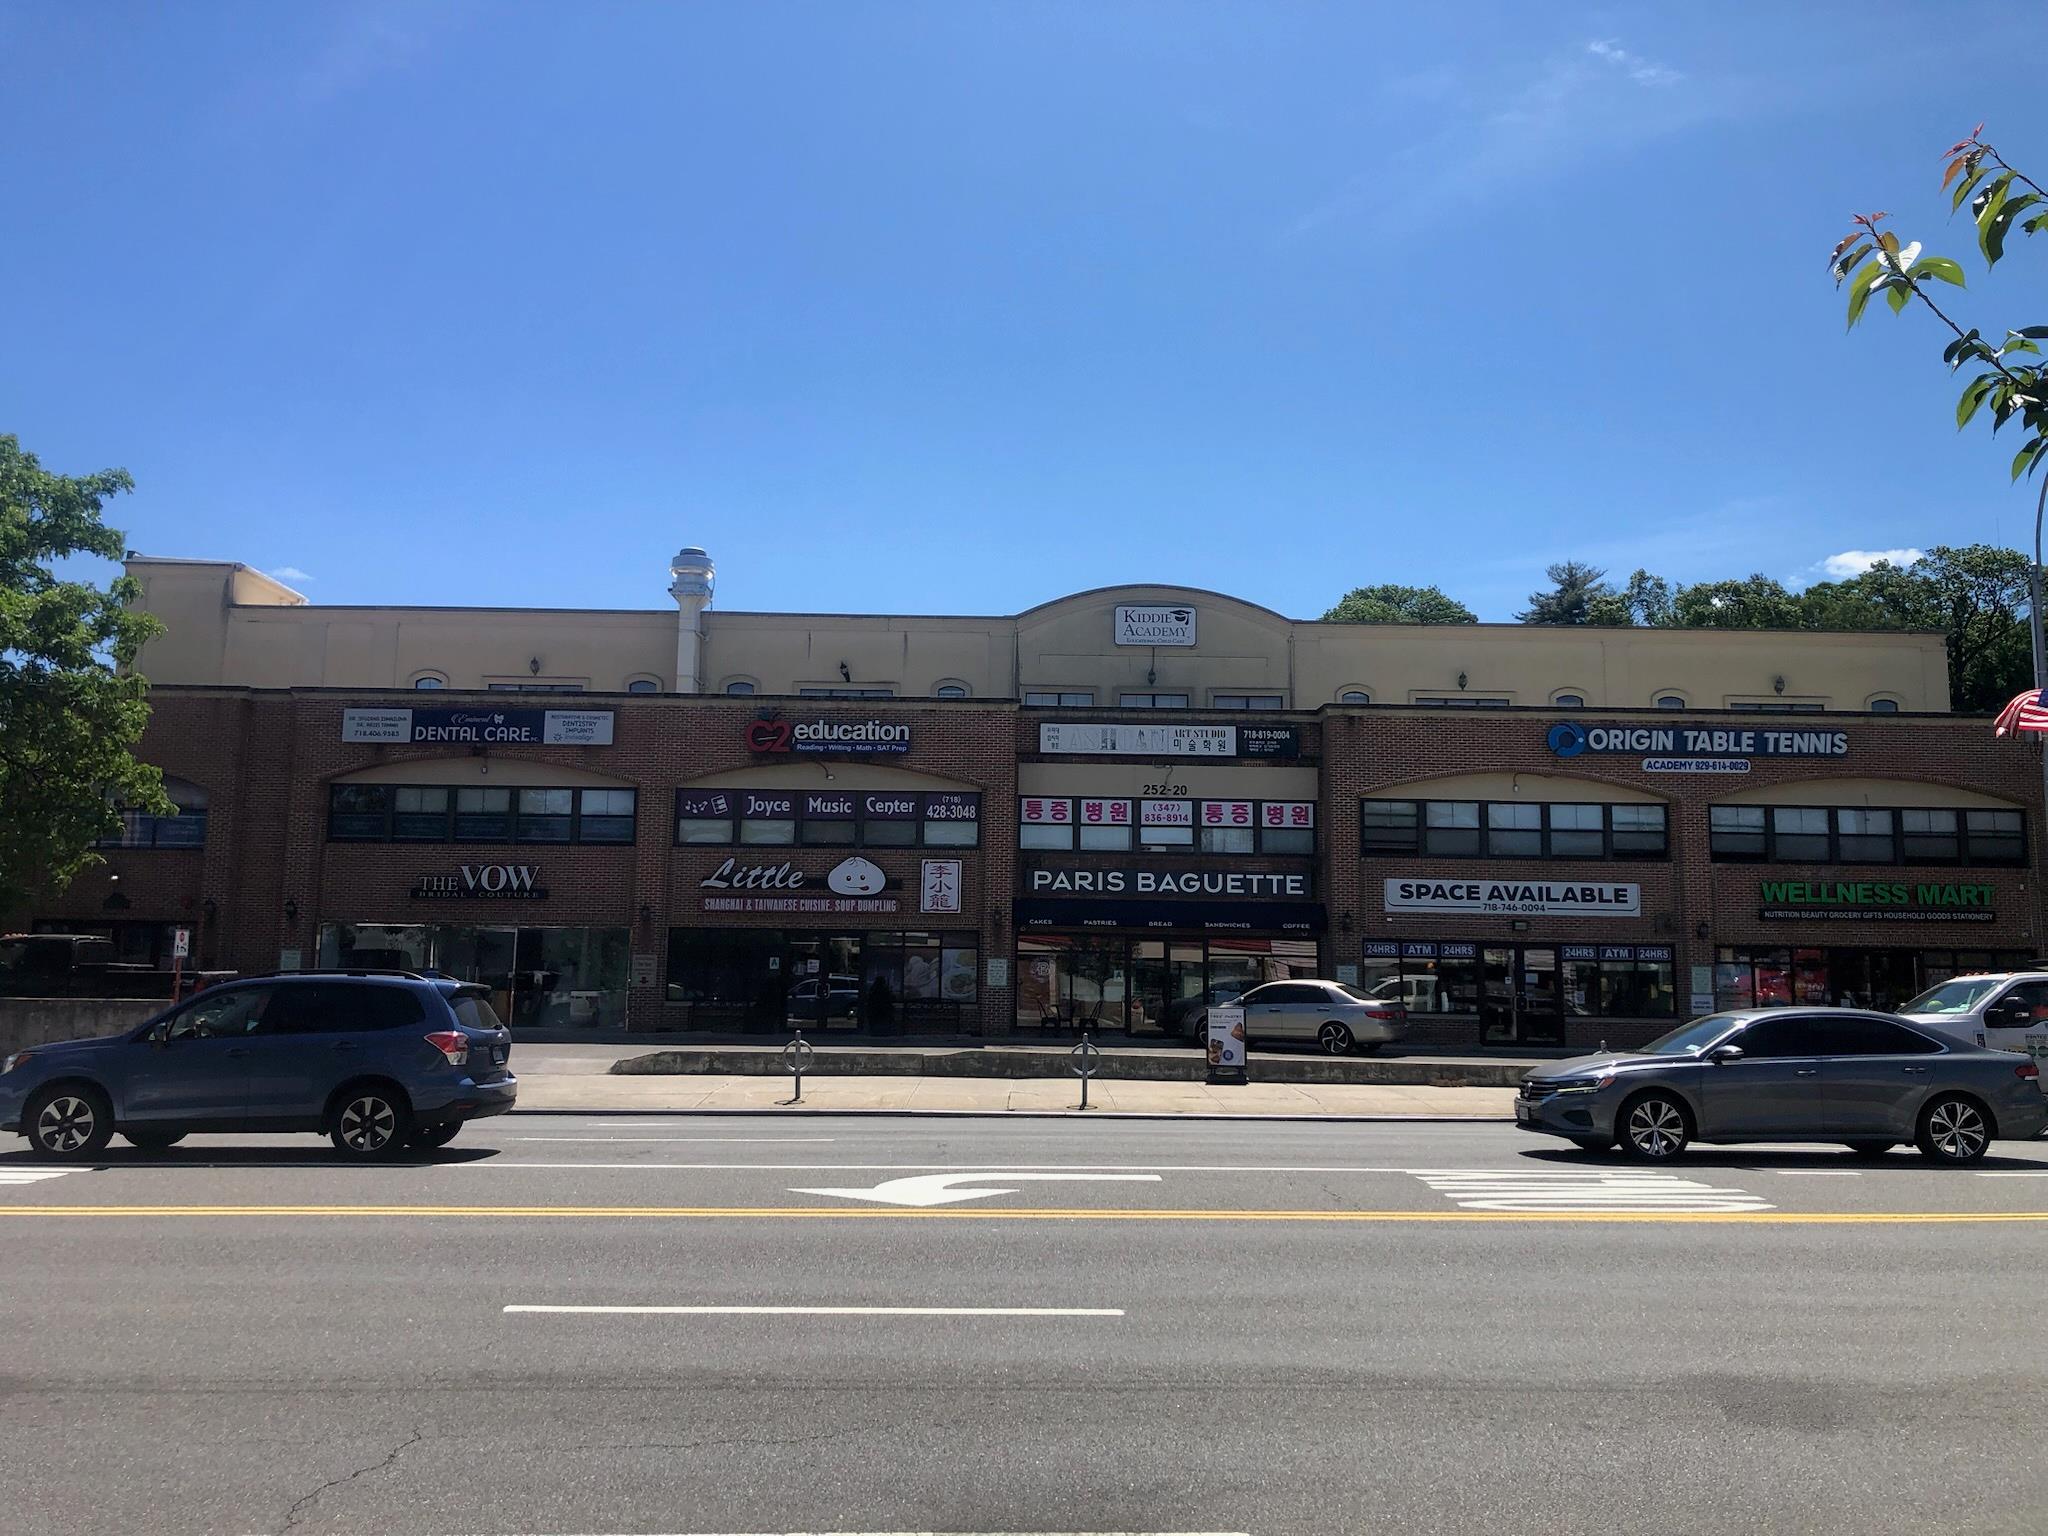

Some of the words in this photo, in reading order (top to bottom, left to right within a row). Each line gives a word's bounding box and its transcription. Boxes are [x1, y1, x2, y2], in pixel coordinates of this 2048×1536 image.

[1124, 609, 1172, 623] KIDDIE
[1123, 623, 1187, 637] ACADEMY
[414, 726, 479, 742] DENTAL
[484, 726, 531, 742] CARE
[794, 719, 910, 741] education
[1174, 729, 1192, 738] ART
[1243, 729, 1290, 740] 718-819-0004
[797, 743, 825, 752] Reading
[828, 744, 852, 752] Writing
[855, 744, 873, 752] Math
[877, 744, 890, 752] SAT
[891, 744, 908, 753] Prep
[1173, 738, 1226, 752] 미술학원
[1588, 727, 1674, 752] ORIGIN
[1683, 729, 1755, 753] TABLE
[1764, 732, 1848, 755] TENNIS
[1646, 761, 1693, 770] ACADEMY
[1695, 761, 1749, 771] 929-614-0029
[1143, 784, 1187, 796] 252-20
[746, 796, 791, 816] Joyce
[808, 797, 852, 814] Music
[866, 796, 915, 816] Center
[926, 804, 976, 819] 428-3048
[1152, 803, 1181, 812] (347)
[1144, 813, 1189, 823] 836-8914
[418, 876, 459, 891] THE
[460, 865, 541, 891] VOW
[700, 858, 807, 890] Little
[1033, 870, 1126, 892] PARIS
[1137, 872, 1305, 895] BAGUETTE
[478, 891, 539, 899] COUTURE
[1399, 883, 1481, 901] SPACE
[1487, 885, 1629, 904] AVAILABLE
[1761, 881, 1910, 905] WELLNESS
[1915, 883, 1997, 907] MART
[704, 898, 743, 911] SHANGHAI
[746, 899, 752, 910] &
[754, 899, 798, 911] TAIWANESE
[835, 900, 854, 911] SOUP
[857, 900, 897, 912] DUMPLING
[1483, 903, 1546, 912] 718-746-0094
[1764, 911, 1800, 919] NUTRITION
[1801, 911, 1828, 919] BEAUTY
[1829, 911, 1861, 919] GROCERY
[1863, 911, 1883, 919] GIFTS
[1884, 911, 1925, 920] HOUSEHOLD
[1926, 912, 1951, 920] GOODS
[1952, 912, 1993, 921] STATIONERY
[1083, 919, 1117, 927] PASTRIES
[1204, 921, 1251, 929] SANDWICHES
[1366, 944, 1397, 954] 24HRS
[1408, 945, 1433, 955] ATM
[1444, 945, 1474, 955] 24HRS
[1565, 948, 1595, 957] 24HRS
[1605, 948, 1629, 958] ATM
[1639, 949, 1669, 959] 24HRS
